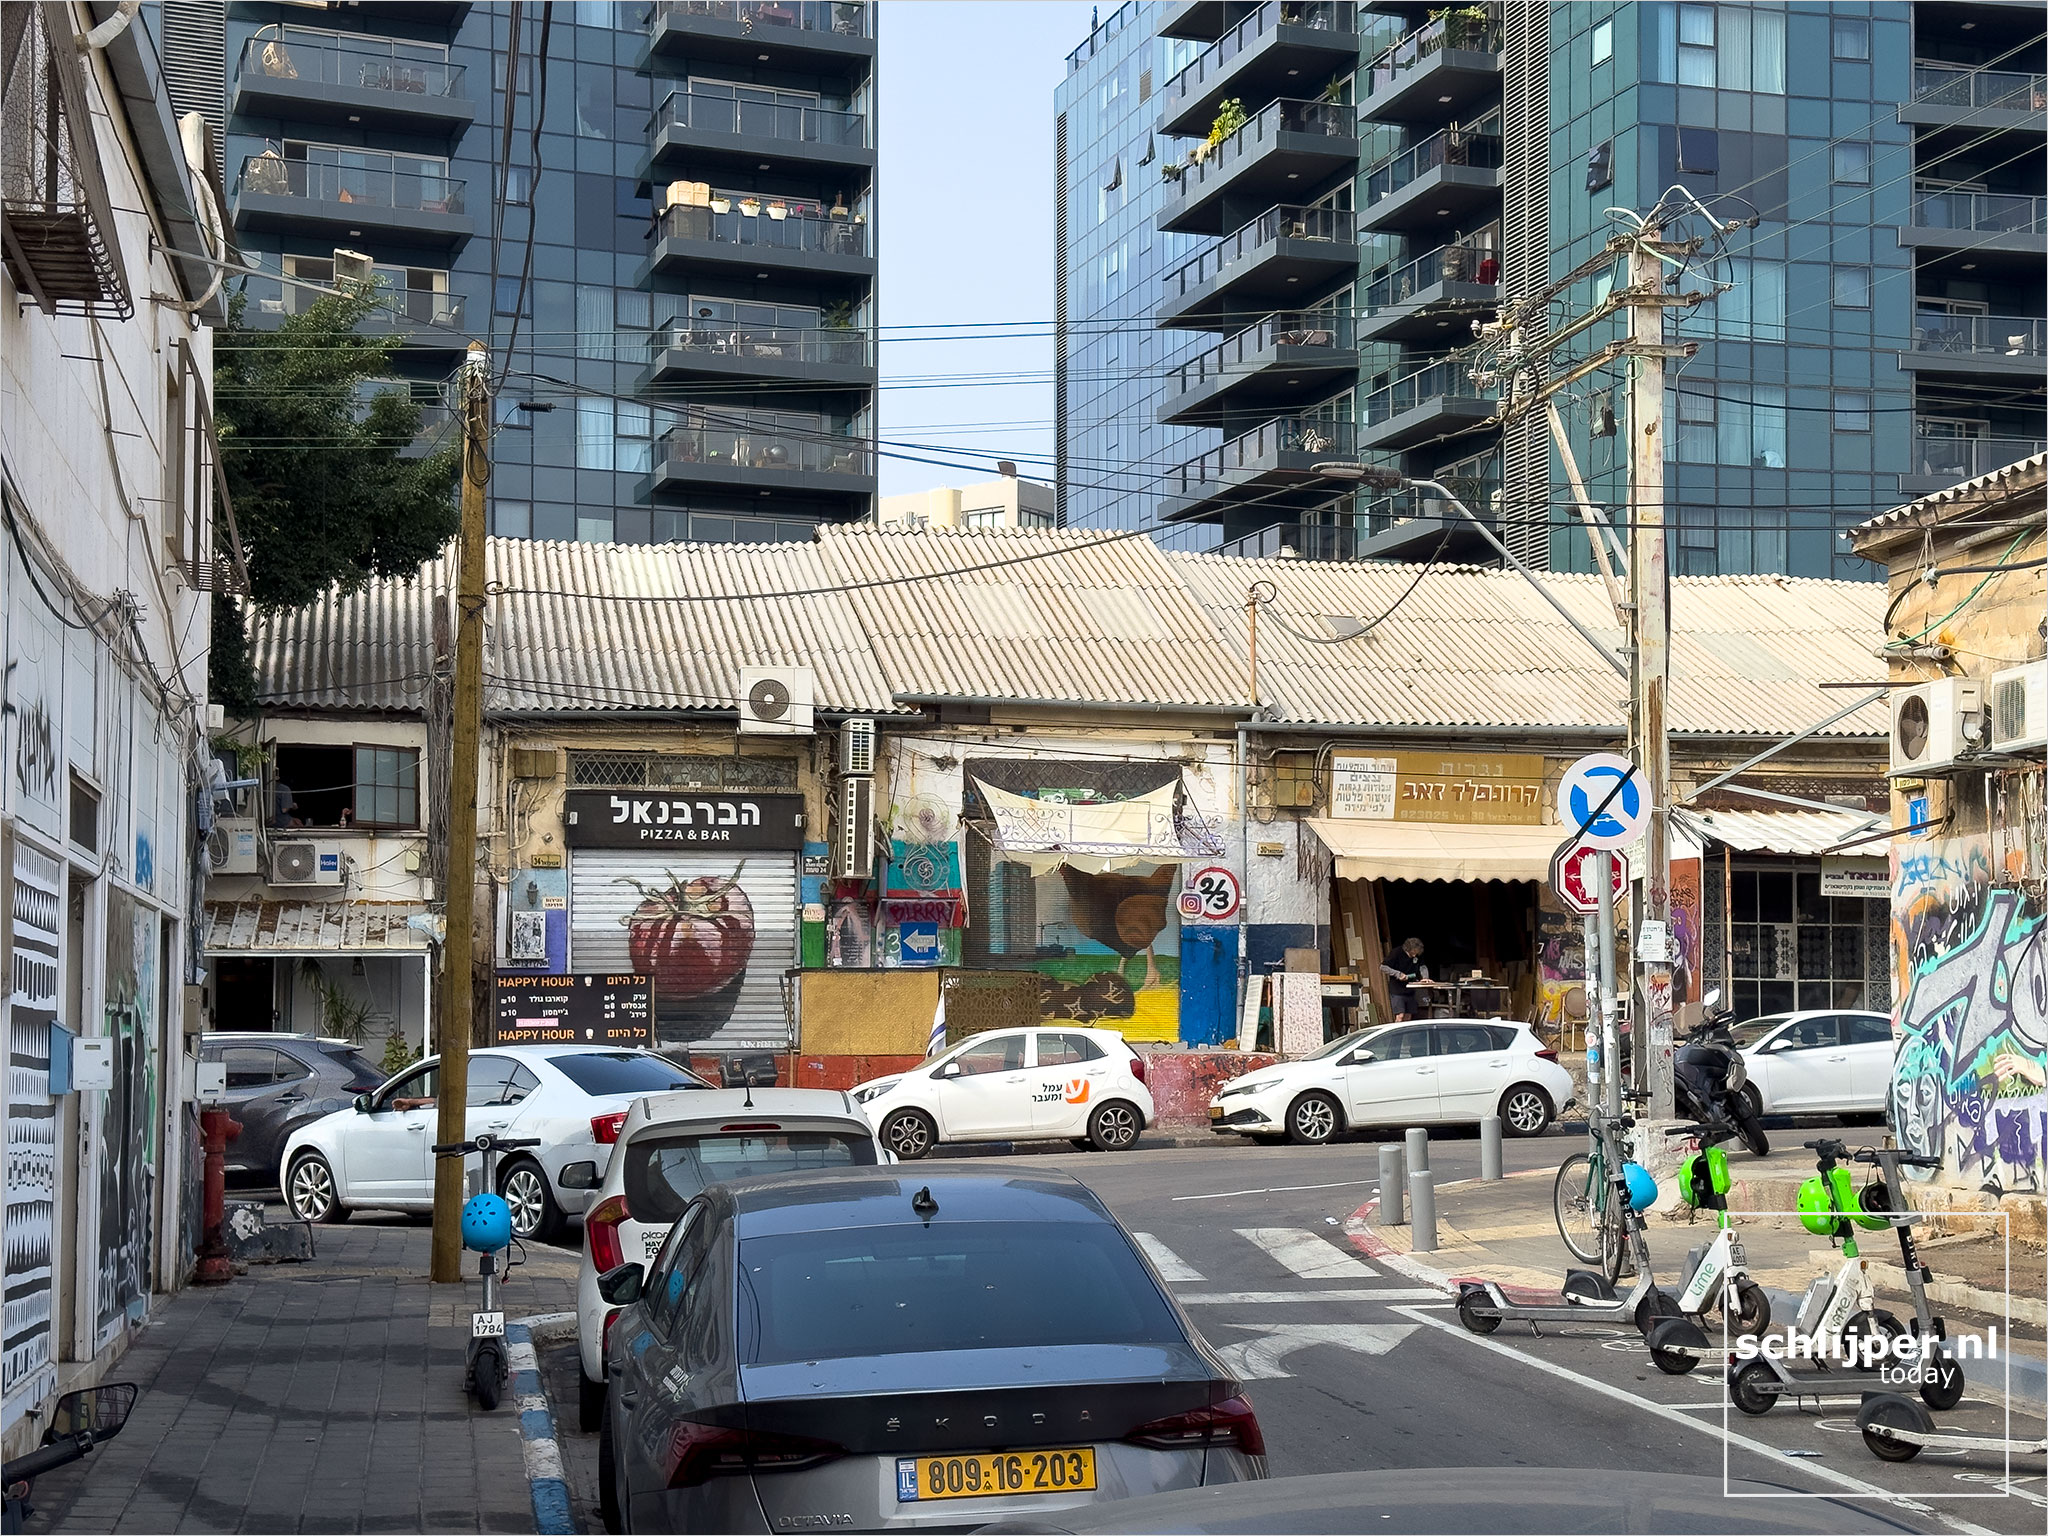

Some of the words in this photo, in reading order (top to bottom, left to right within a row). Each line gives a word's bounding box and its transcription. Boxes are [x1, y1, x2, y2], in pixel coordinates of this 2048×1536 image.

[1401, 782, 1446, 802] זאב
[610, 795, 760, 826] הברבנאל
[640, 829, 684, 840] PIZZA
[687, 830, 698, 840] &
[701, 830, 730, 841] BAR
[497, 976, 538, 987] HAPPY
[541, 976, 574, 987] HOUR
[607, 976, 630, 985] היום
[633, 975, 646, 985] כל
[498, 1029, 539, 1040] HAPPY
[541, 1029, 575, 1040] HOUR
[607, 1028, 631, 1038] היום
[633, 1027, 647, 1037] כל
[1042, 1082, 1063, 1092] עמל
[1031, 1093, 1062, 1102] ומעבר
[475, 1324, 503, 1336] 1784
[778, 1513, 854, 1527] OCTAVIA
